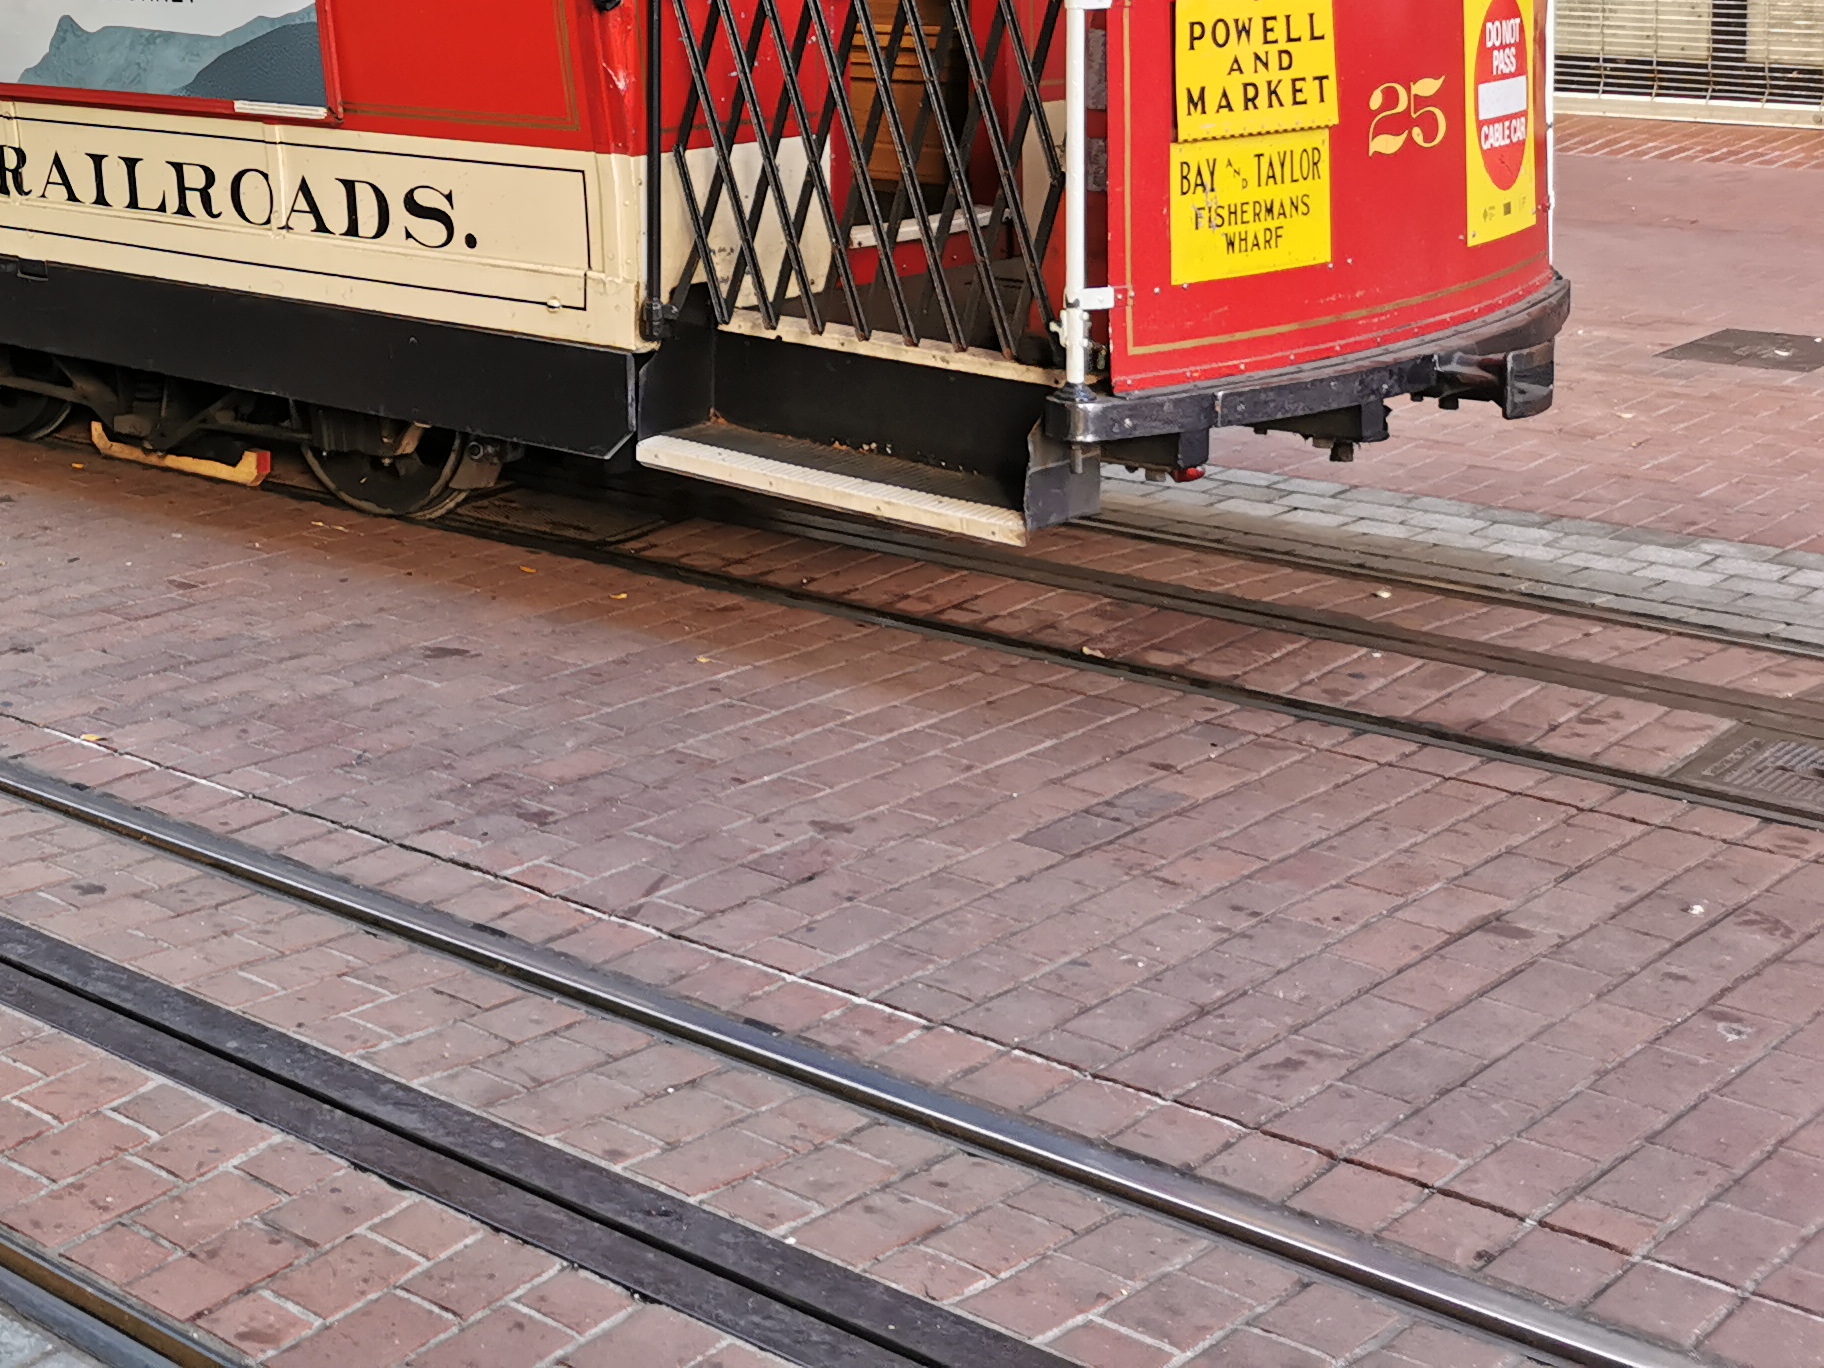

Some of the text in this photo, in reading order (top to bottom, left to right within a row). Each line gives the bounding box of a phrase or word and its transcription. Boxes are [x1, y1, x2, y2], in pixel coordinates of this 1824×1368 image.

[1187, 12, 1326, 50] POWELL
[1485, 17, 1521, 49] DO NOT
[1227, 49, 1294, 75] AND
[1492, 47, 1517, 75] PASS
[1186, 75, 1330, 117] MARKET
[1369, 75, 1446, 158] 25
[1480, 116, 1526, 150] CABLE CAR
[1179, 147, 1322, 197] BAY AND TAYLOR
[1194, 194, 1311, 232] FISHERMANS
[1225, 227, 1284, 255] WHARF
